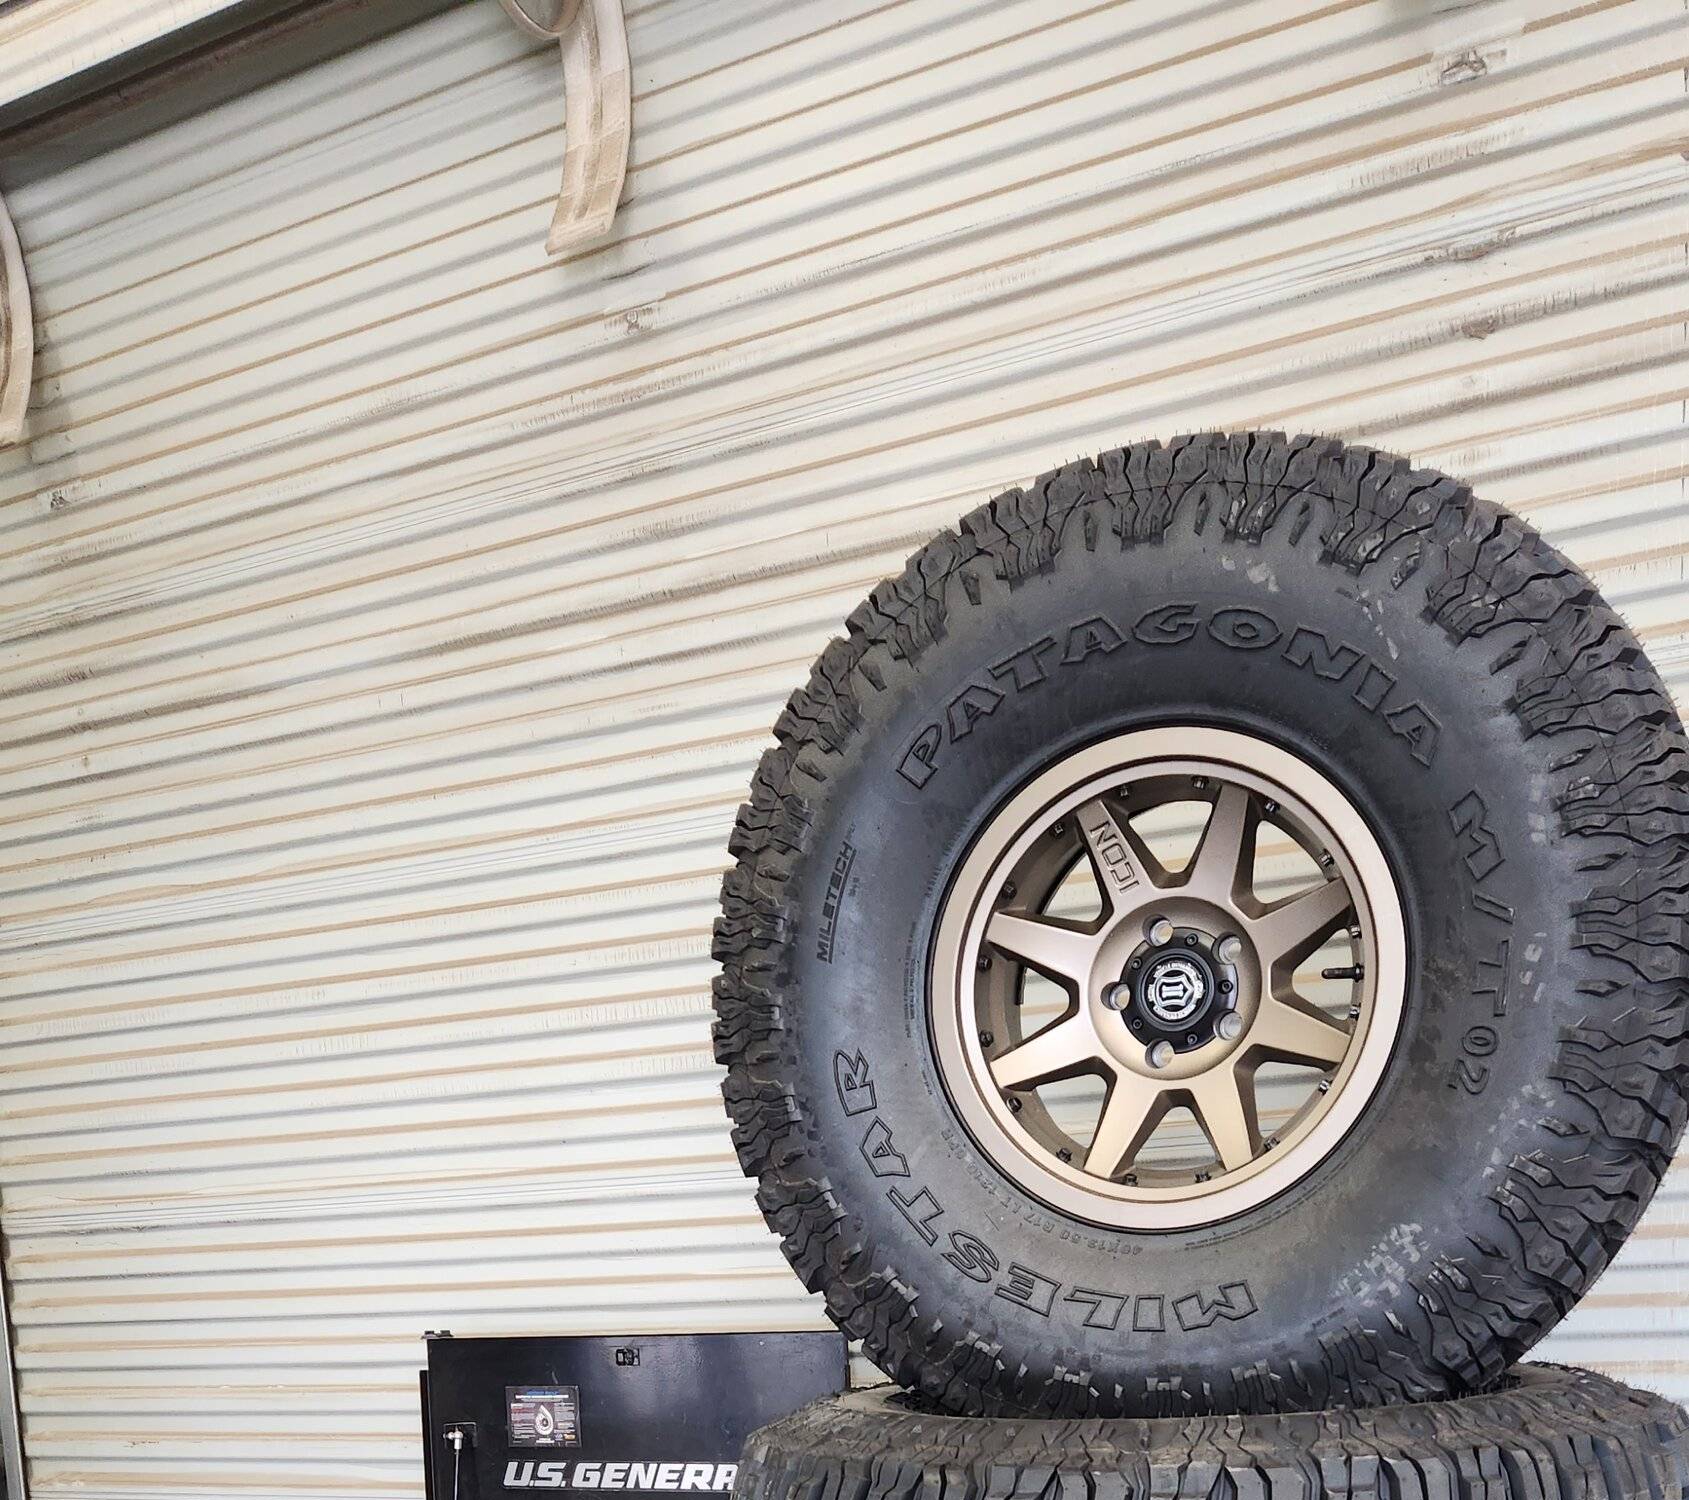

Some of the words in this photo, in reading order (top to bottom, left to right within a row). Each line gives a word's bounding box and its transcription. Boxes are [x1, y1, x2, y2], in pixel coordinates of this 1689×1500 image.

[895, 602, 1443, 789] PATAGONIA
[816, 840, 854, 963] MILETECH
[1089, 820, 1140, 894] ICON
[832, 1047, 1258, 1333] MILESTAR
[571, 1462, 738, 1490] GENERA
